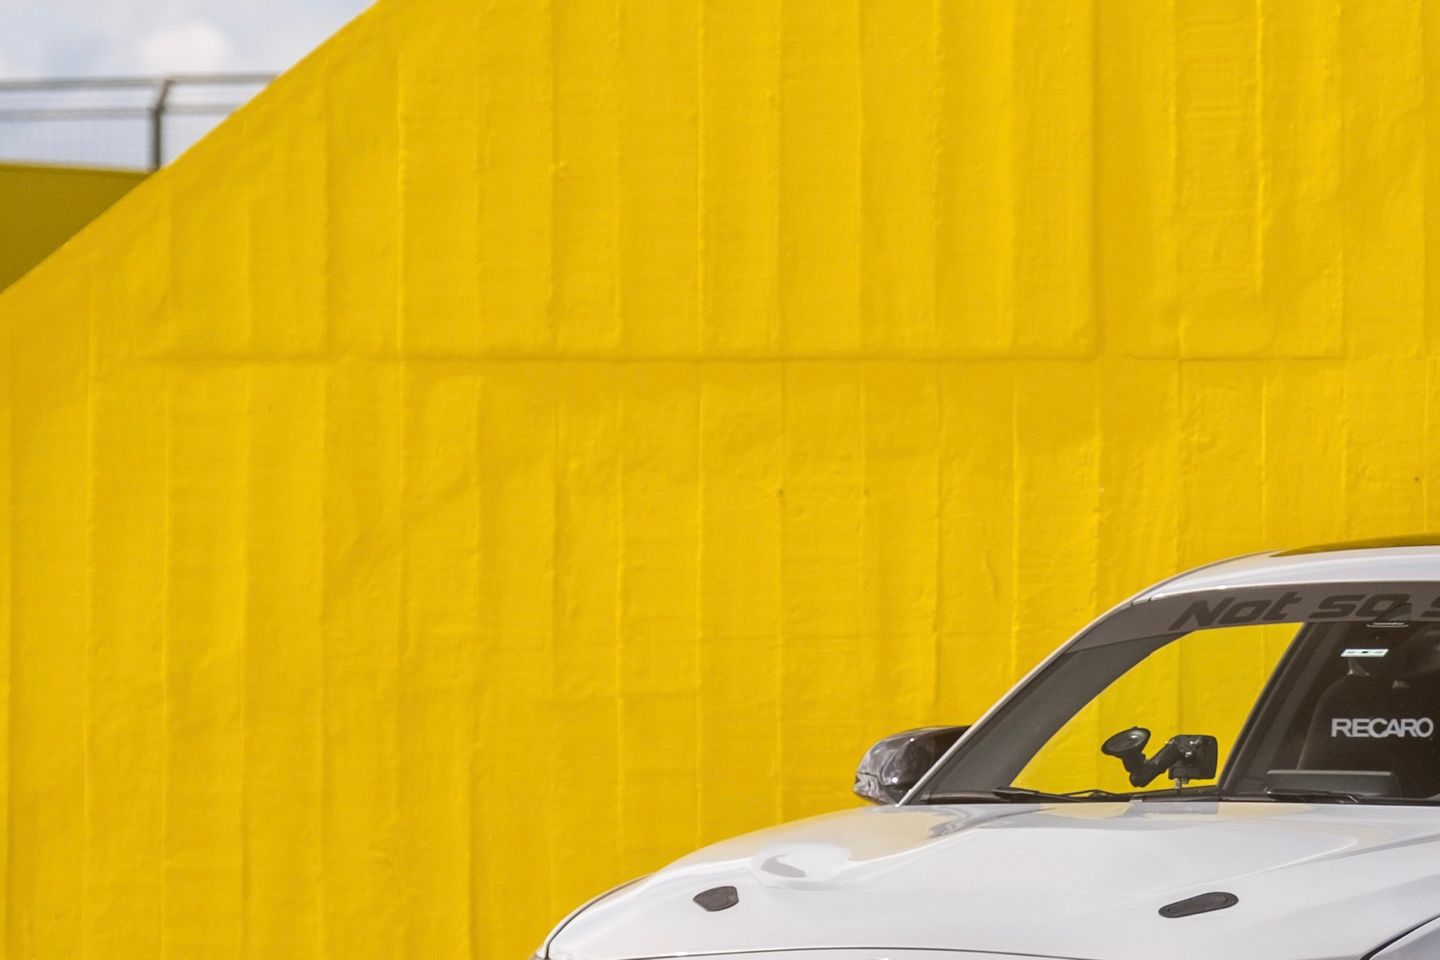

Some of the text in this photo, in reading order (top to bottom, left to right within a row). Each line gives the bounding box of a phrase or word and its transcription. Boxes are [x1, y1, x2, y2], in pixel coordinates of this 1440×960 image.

[1168, 591, 1302, 631] Not
[1309, 593, 1412, 622] so
[1331, 717, 1434, 738] RECARO
